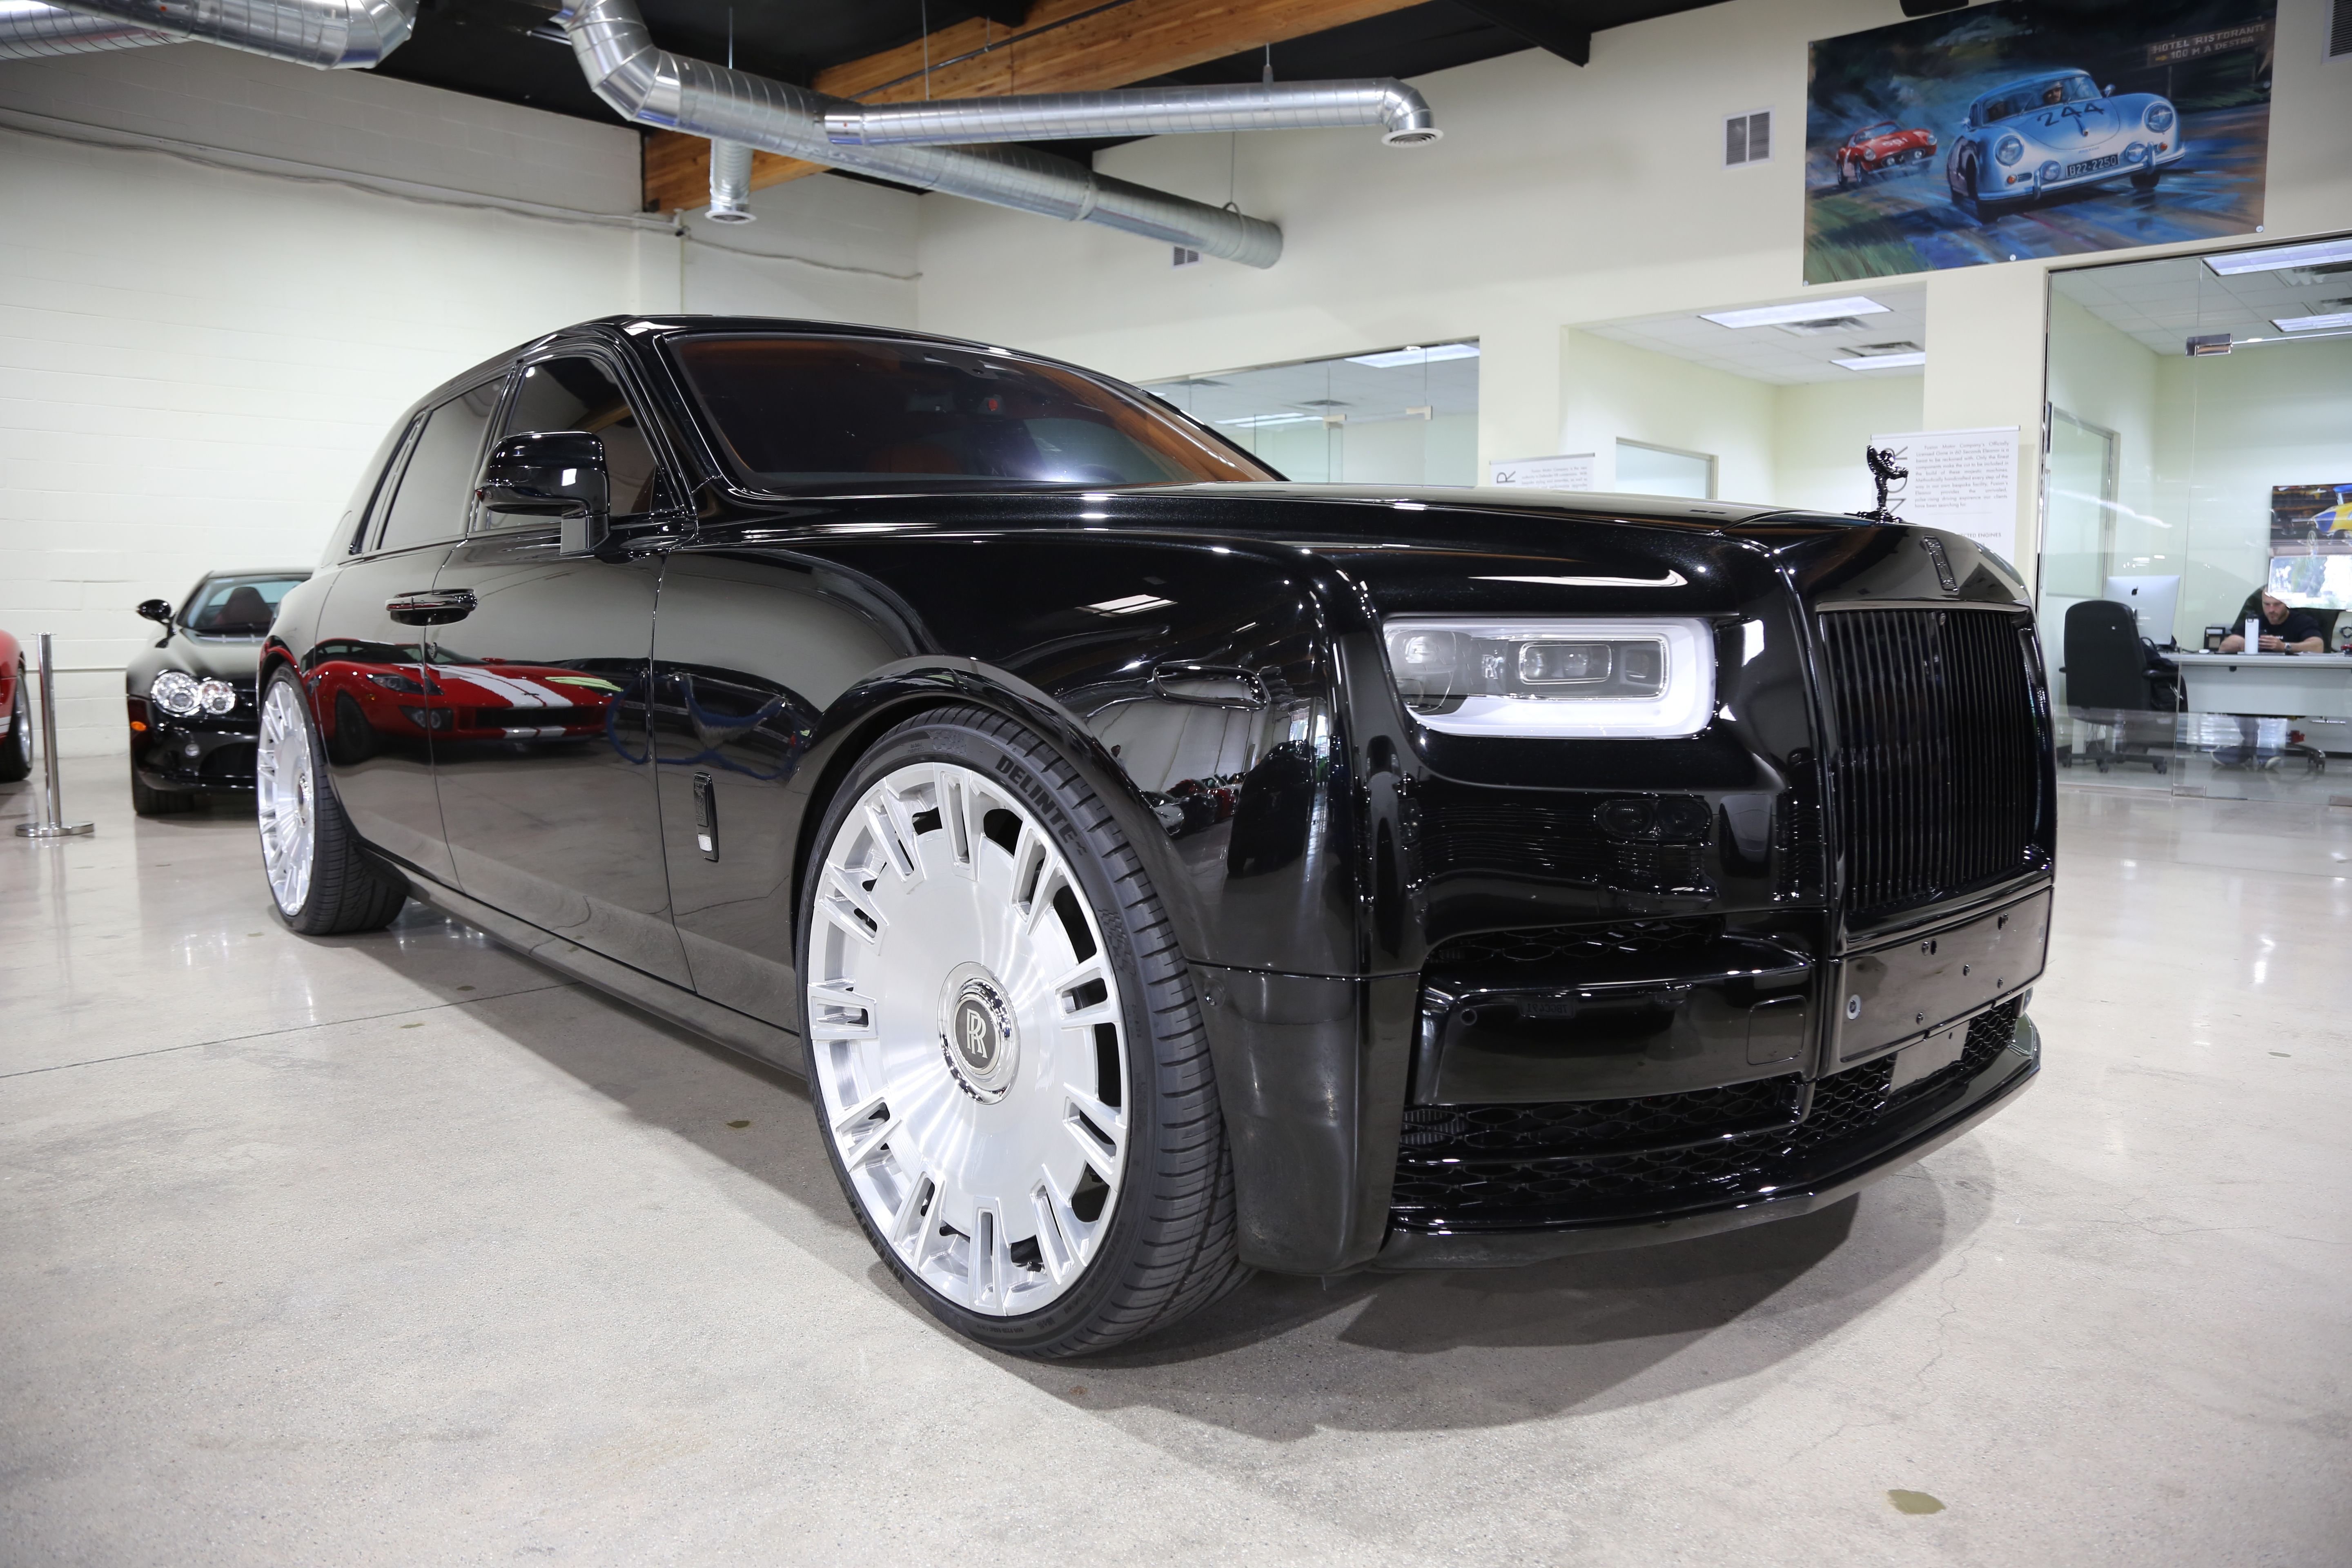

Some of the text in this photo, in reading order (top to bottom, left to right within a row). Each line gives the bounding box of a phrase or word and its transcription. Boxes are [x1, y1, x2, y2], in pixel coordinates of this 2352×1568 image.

[2151, 23, 2266, 53] HOTEL RISTORANTE
[2171, 49, 2188, 59] 100
[2214, 36, 2254, 50] DESTRA
[2037, 103, 2105, 127] 244
[995, 754, 1078, 844] DELINTE
